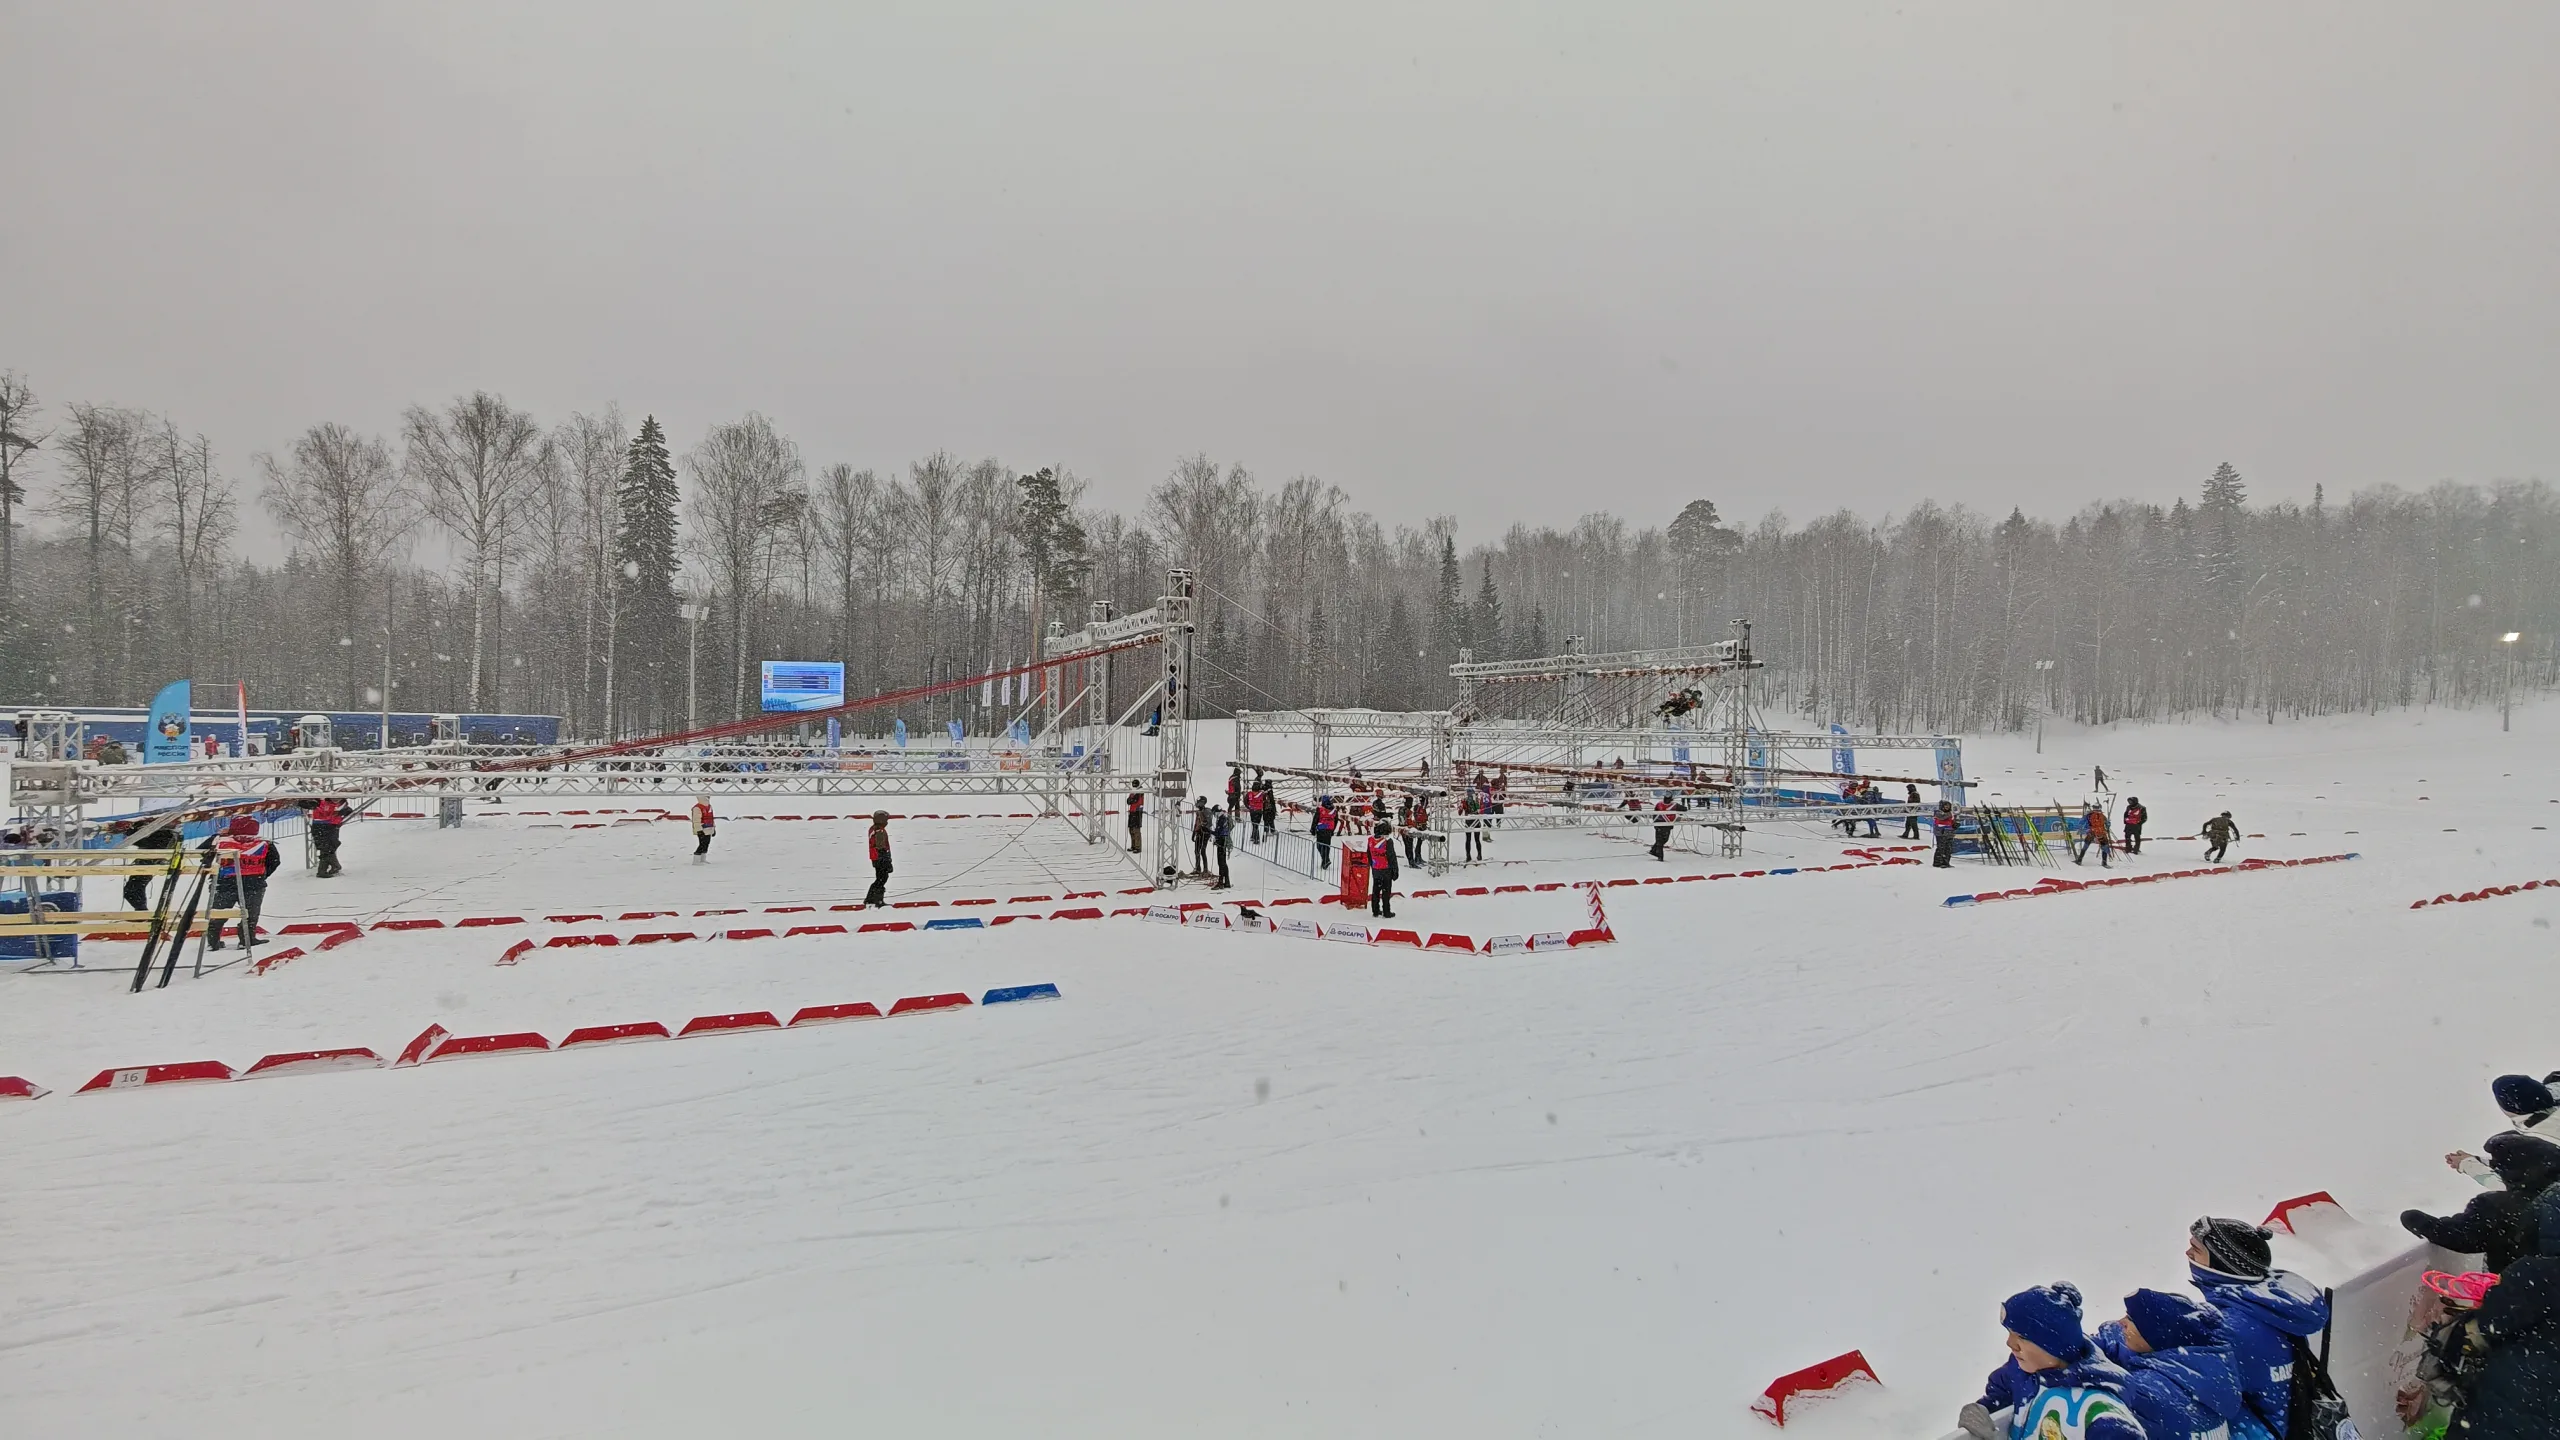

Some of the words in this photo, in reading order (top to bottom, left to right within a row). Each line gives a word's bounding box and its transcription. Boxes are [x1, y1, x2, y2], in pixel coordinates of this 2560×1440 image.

[1154, 912, 1179, 920] ФОСАГРО
[1204, 916, 1220, 924] ПСБ
[1337, 930, 1365, 938] ФОСАГРО
[120, 1072, 139, 1083] 16
